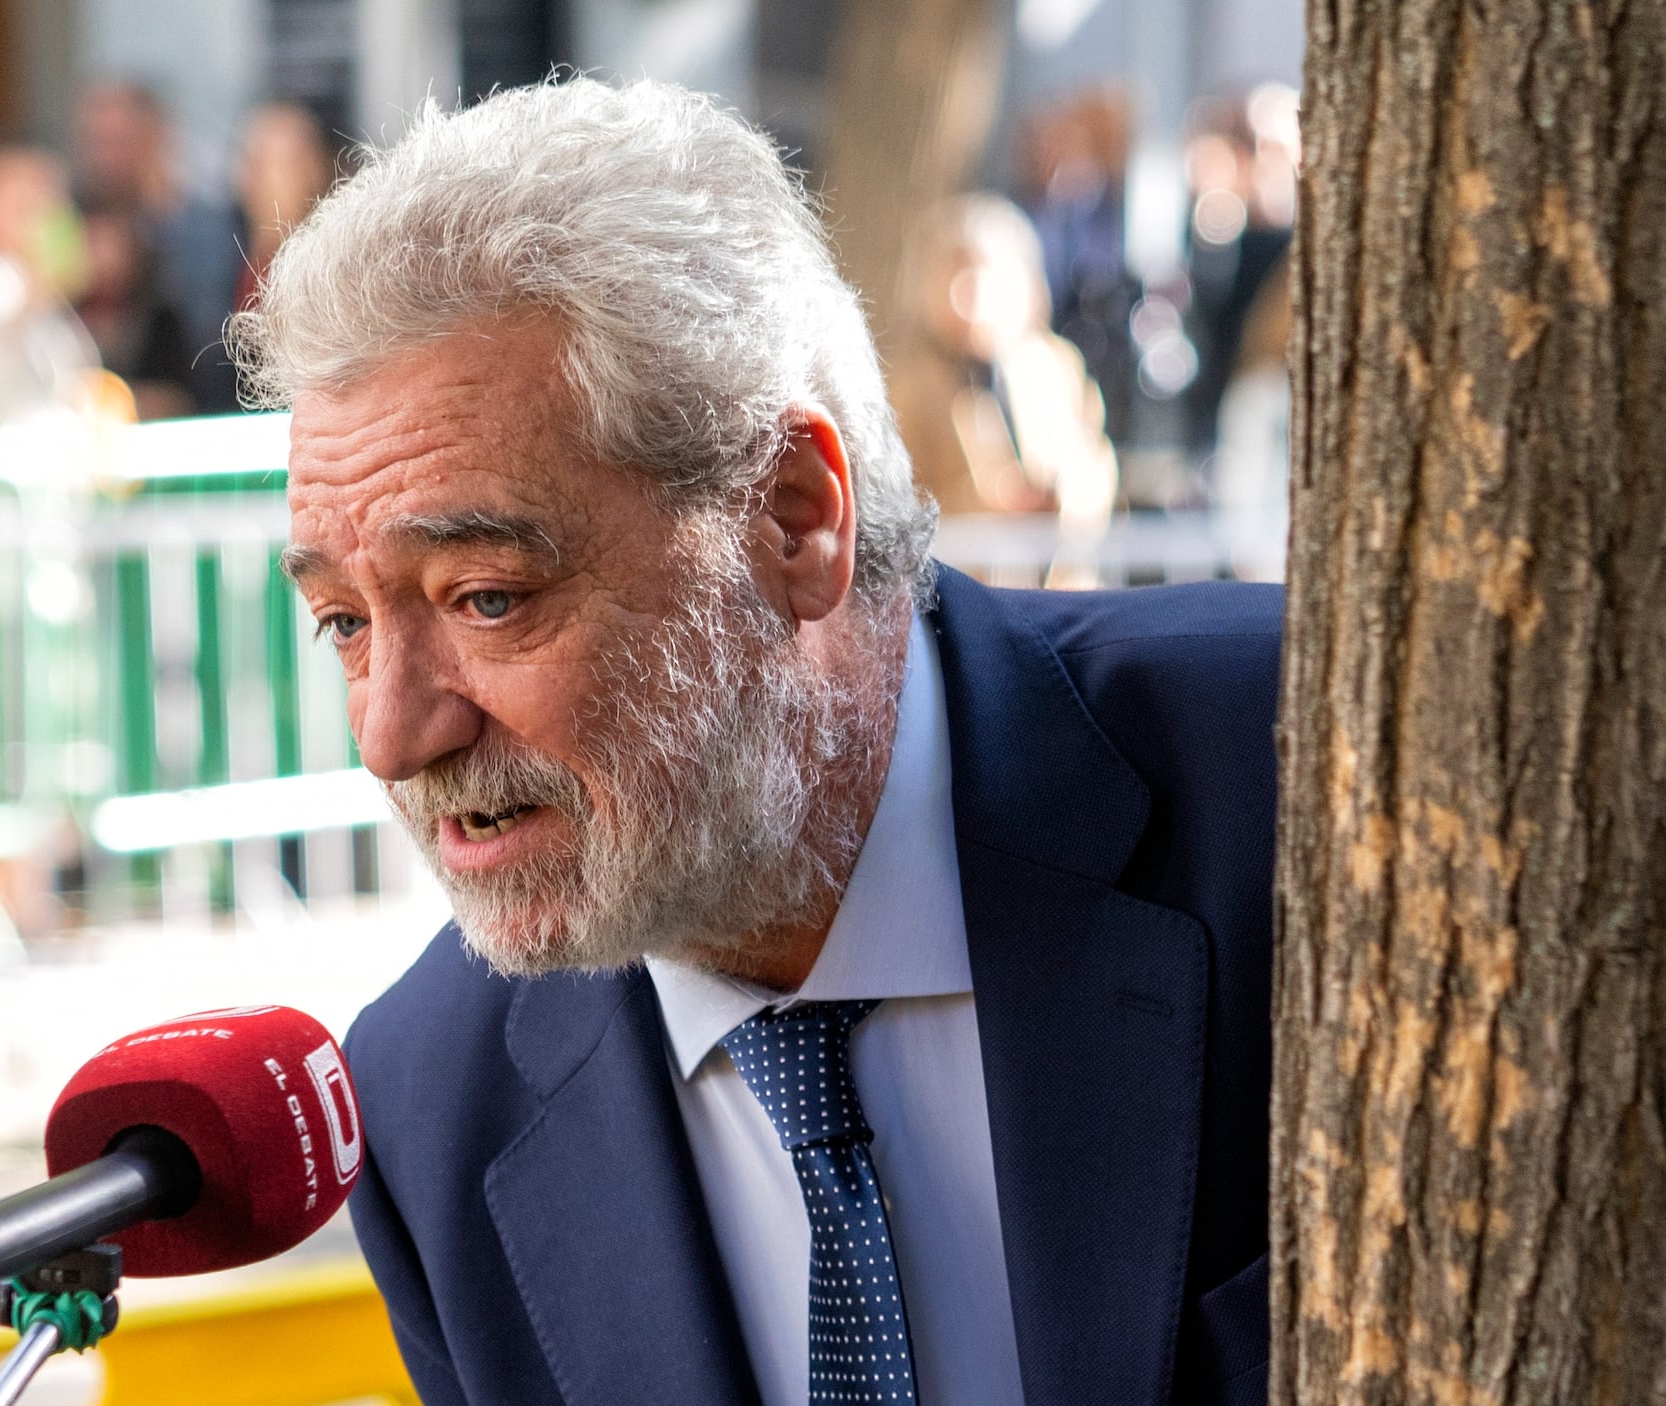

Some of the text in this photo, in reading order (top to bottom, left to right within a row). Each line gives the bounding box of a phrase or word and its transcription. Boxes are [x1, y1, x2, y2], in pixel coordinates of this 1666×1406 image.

[126, 1029, 234, 1047] DEBATE
[264, 1057, 318, 1211] EL DEBATE
